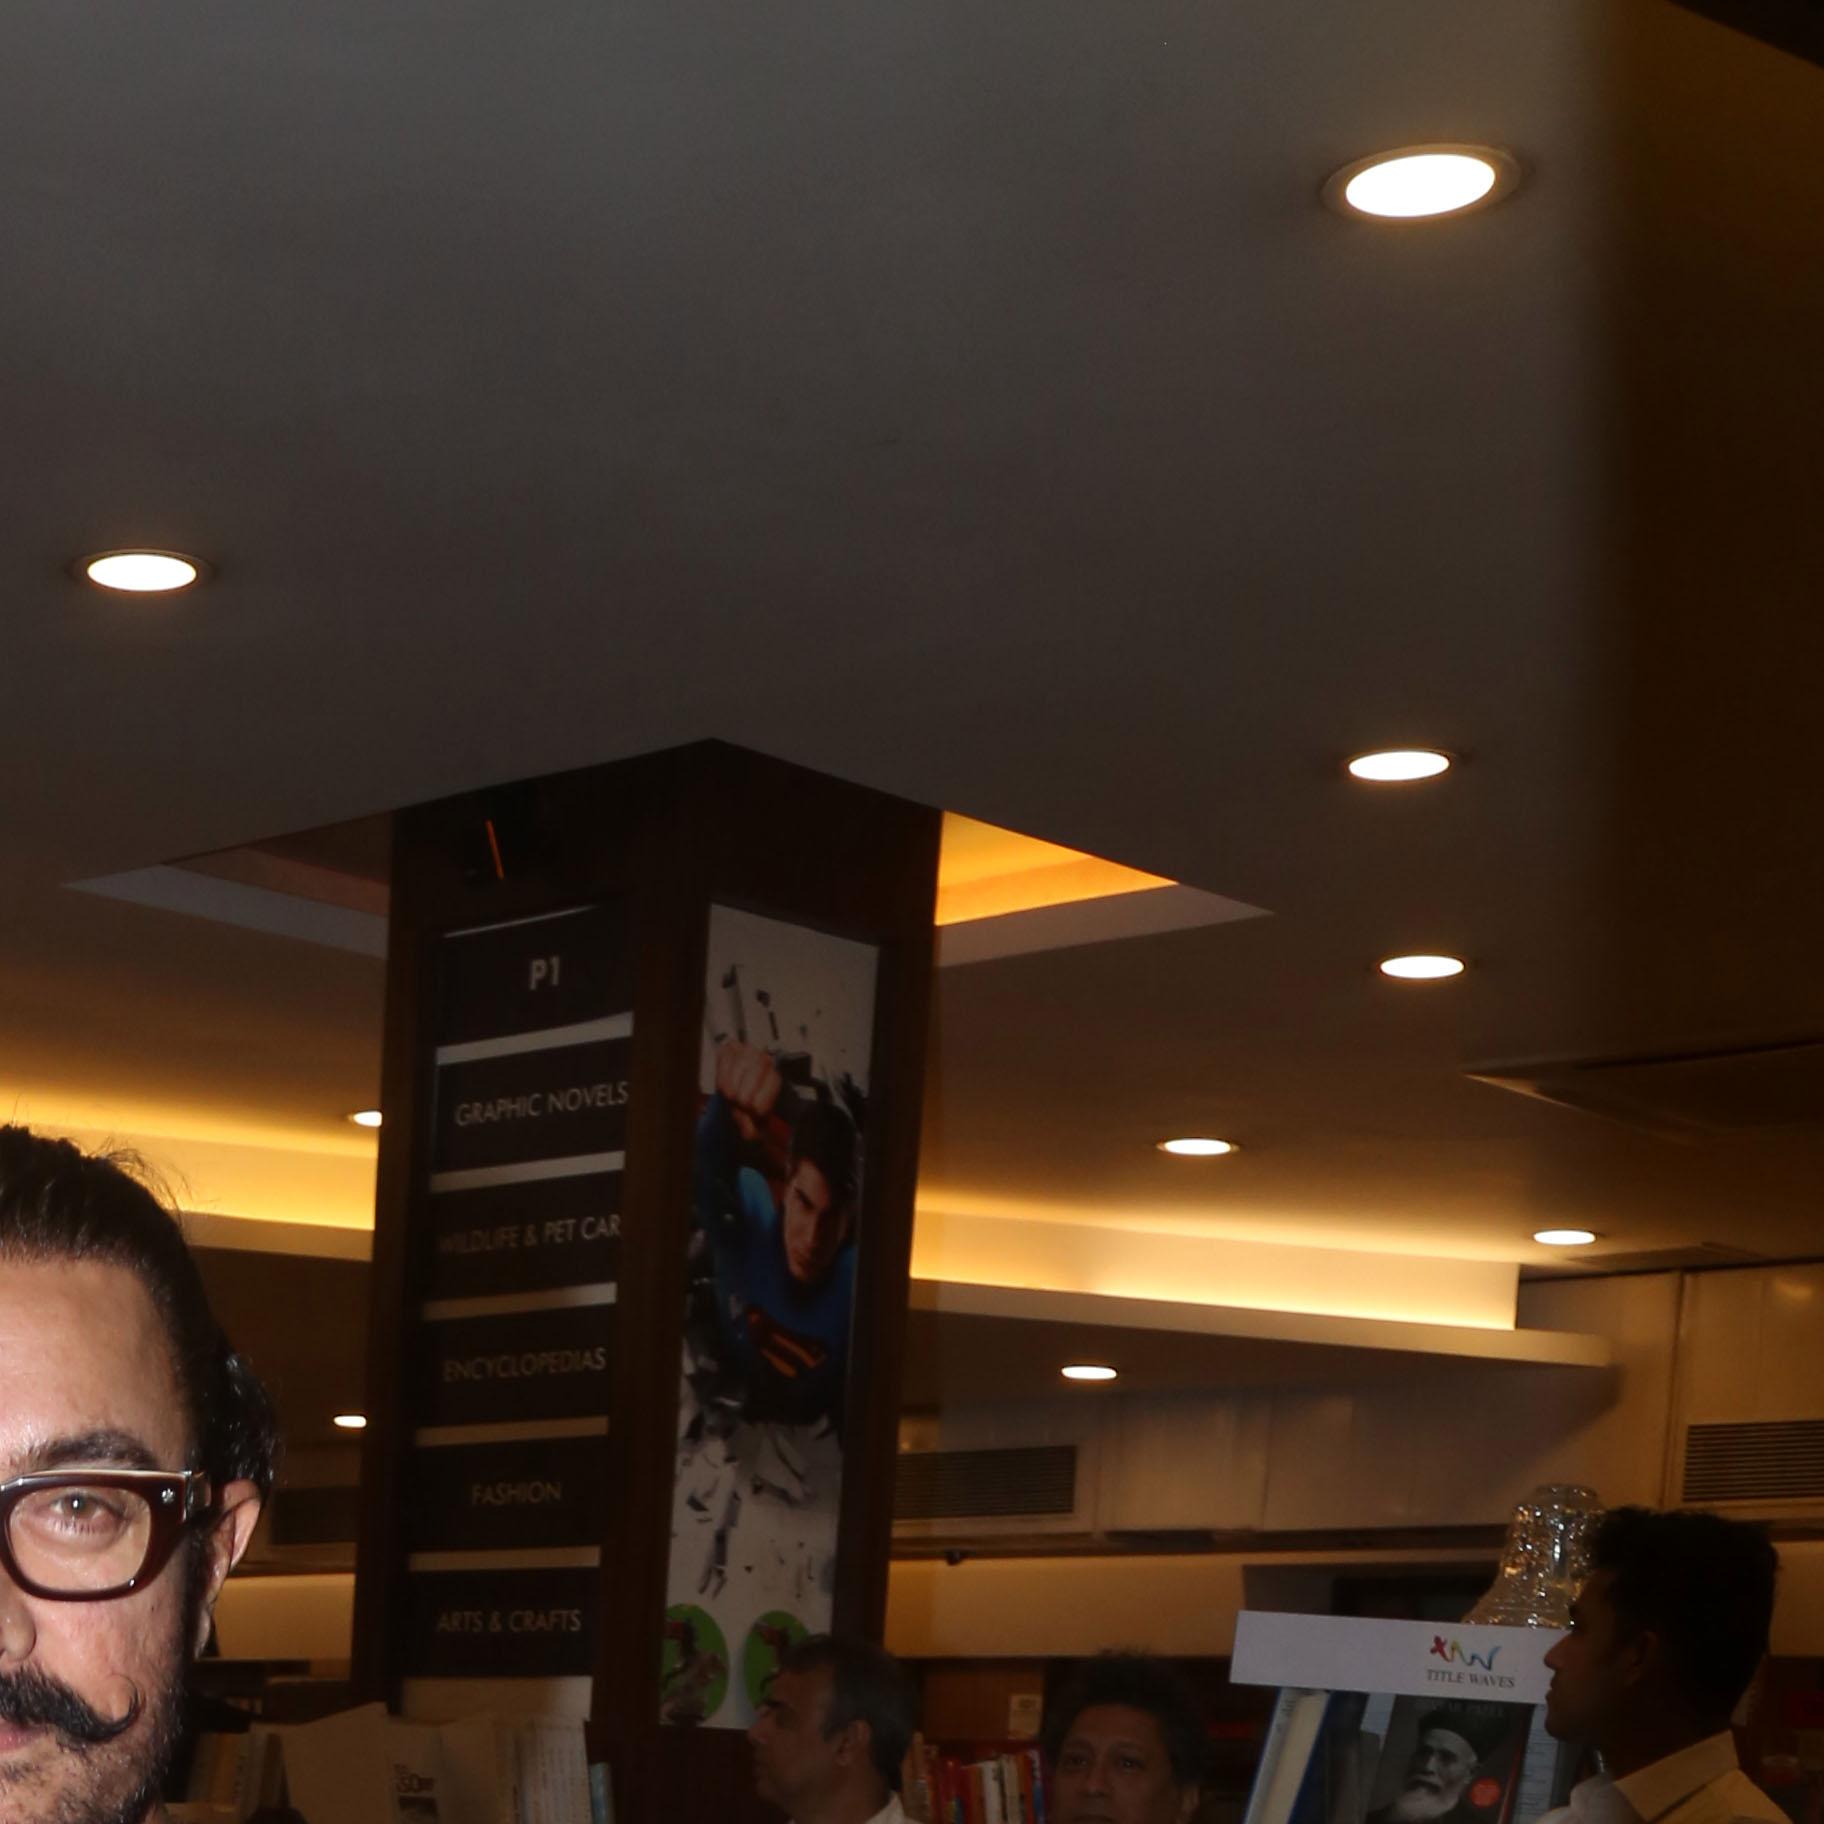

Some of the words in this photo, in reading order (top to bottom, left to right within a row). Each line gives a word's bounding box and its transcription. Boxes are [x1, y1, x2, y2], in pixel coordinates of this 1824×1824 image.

[528, 955, 561, 991] P1
[453, 1090, 544, 1127] GRAPHIC
[547, 1080, 631, 1113] NOVELS
[438, 1222, 519, 1255] WILDLIFE
[525, 1221, 538, 1248] &
[542, 1219, 576, 1245] PET
[442, 1347, 608, 1383] ENCYCLOPEDIAS
[470, 1481, 563, 1506] FASHION
[435, 1610, 483, 1634] ARTS
[488, 1611, 502, 1633] &
[508, 1608, 582, 1633] CRAFTS
[1426, 1668, 1466, 1686] TITLE
[1469, 1674, 1516, 1690] WAVES
